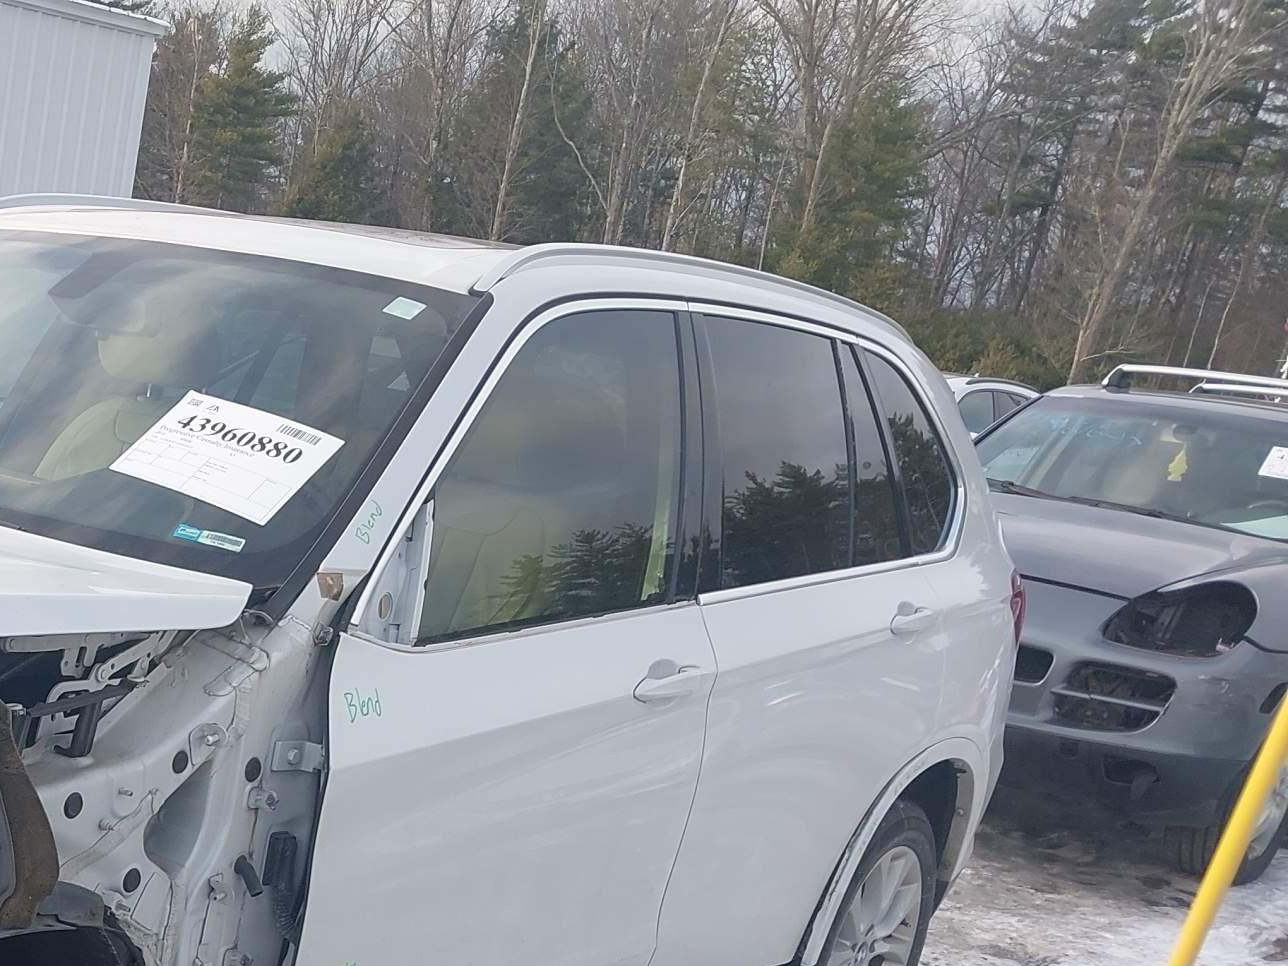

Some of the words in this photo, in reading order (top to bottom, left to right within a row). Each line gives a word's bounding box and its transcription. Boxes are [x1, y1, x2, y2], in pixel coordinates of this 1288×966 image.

[176, 413, 304, 464] 43960880
[354, 502, 384, 545] Blend
[344, 687, 383, 724] Blend
